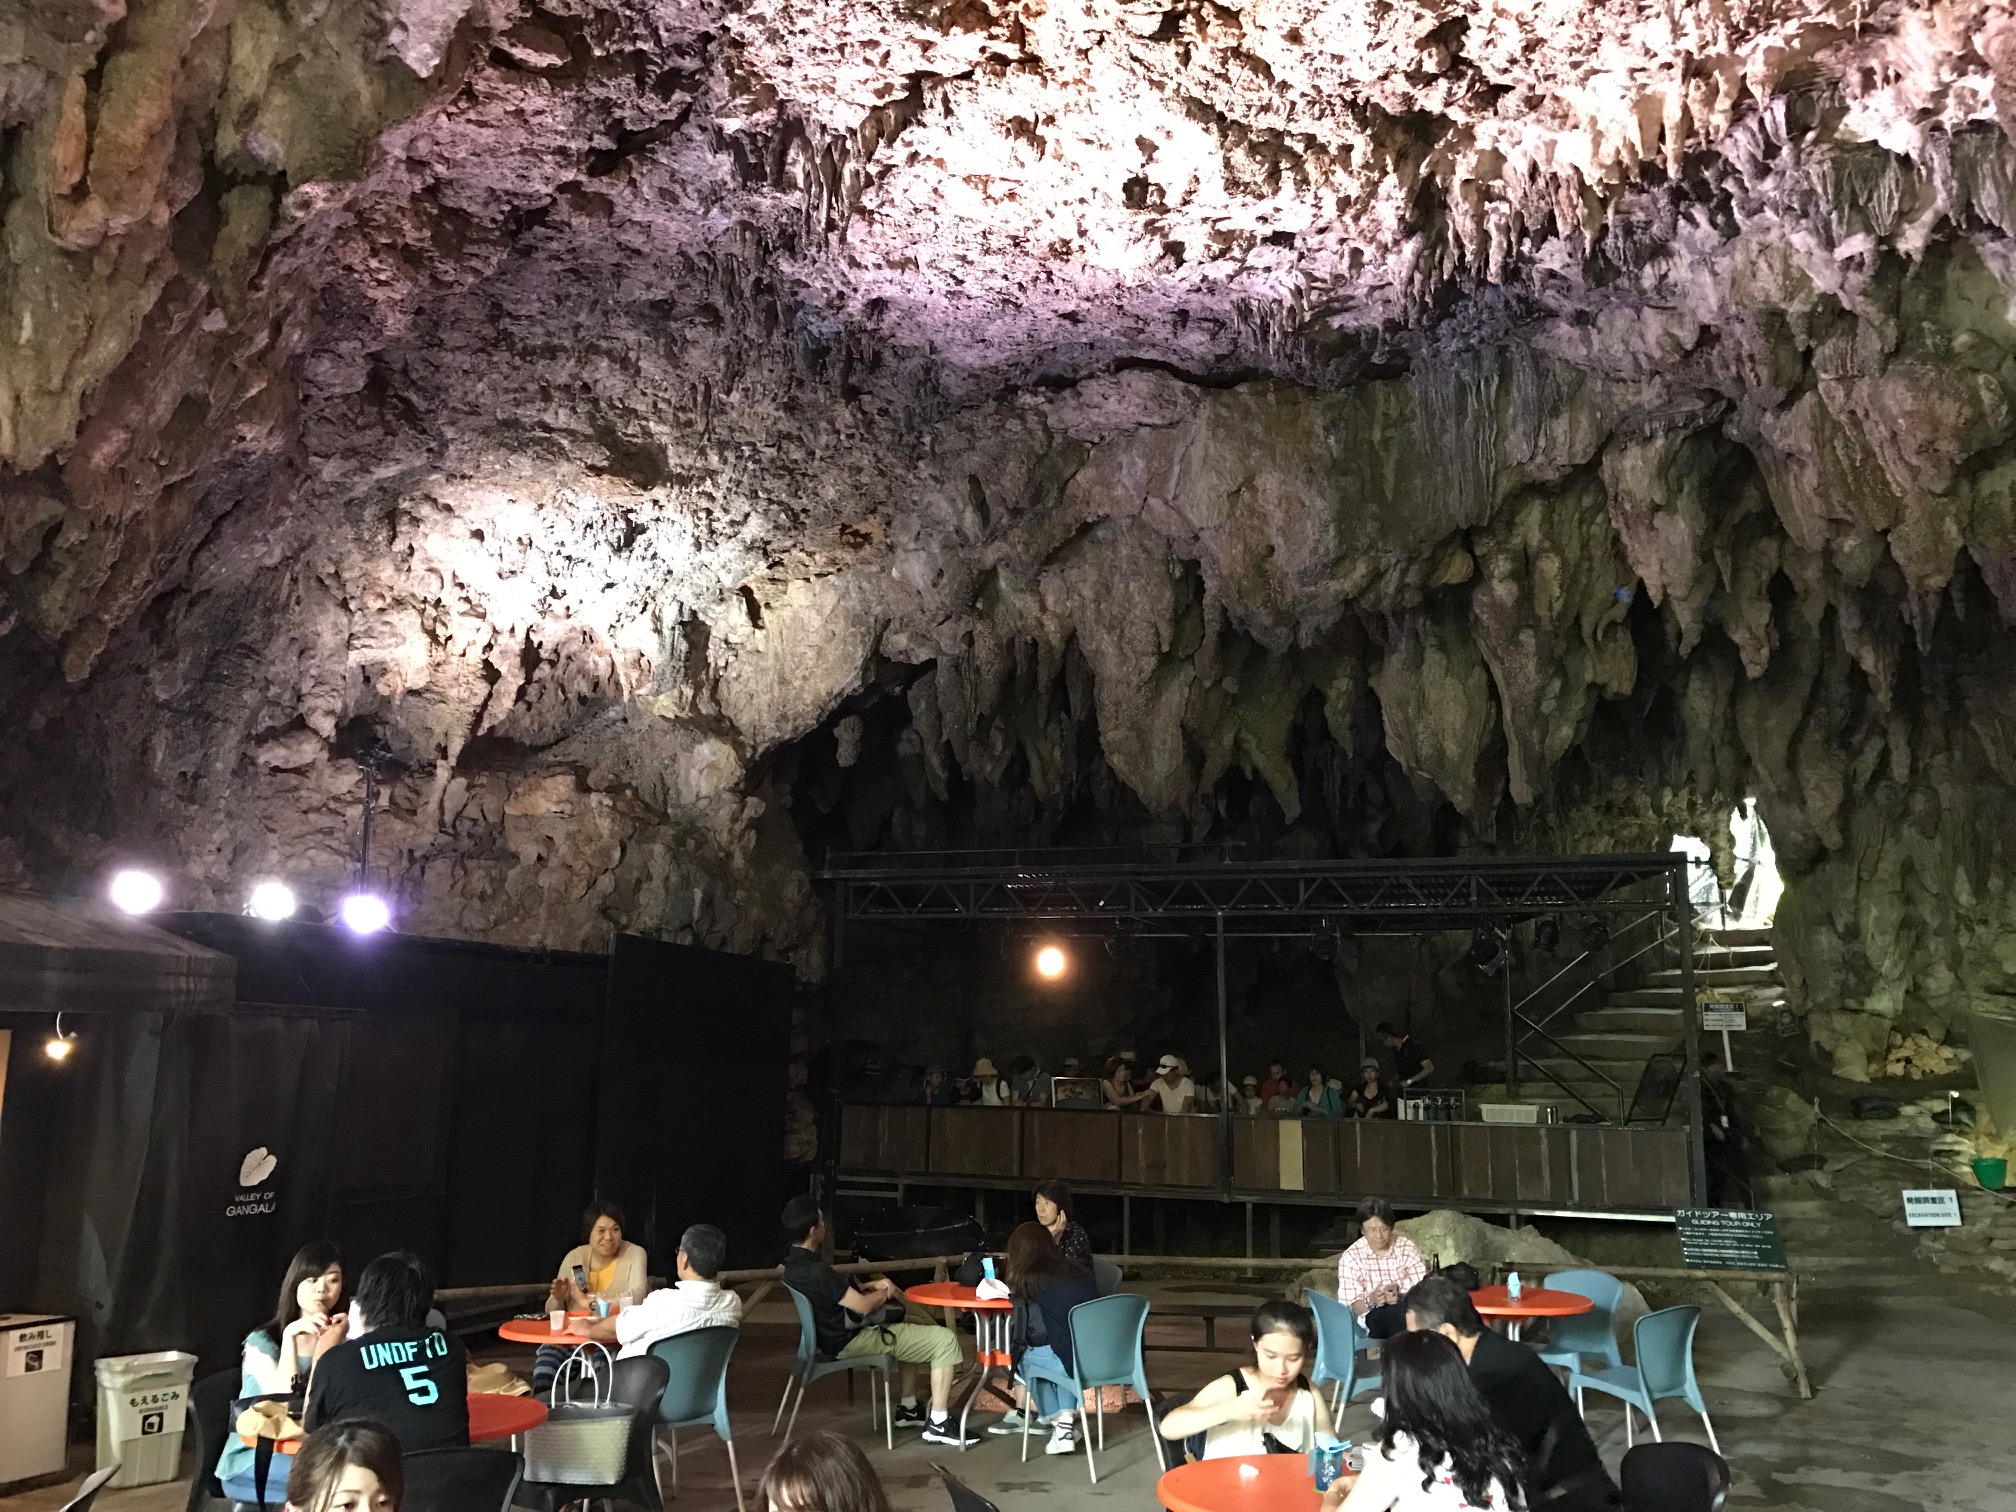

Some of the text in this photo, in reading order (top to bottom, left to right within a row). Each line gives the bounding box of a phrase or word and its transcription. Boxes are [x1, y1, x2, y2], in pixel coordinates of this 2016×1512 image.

[235, 1192, 276, 1202] VALLEY OF
[399, 1365, 439, 1406] 5
[130, 1391, 180, 1407] もえるごみ
